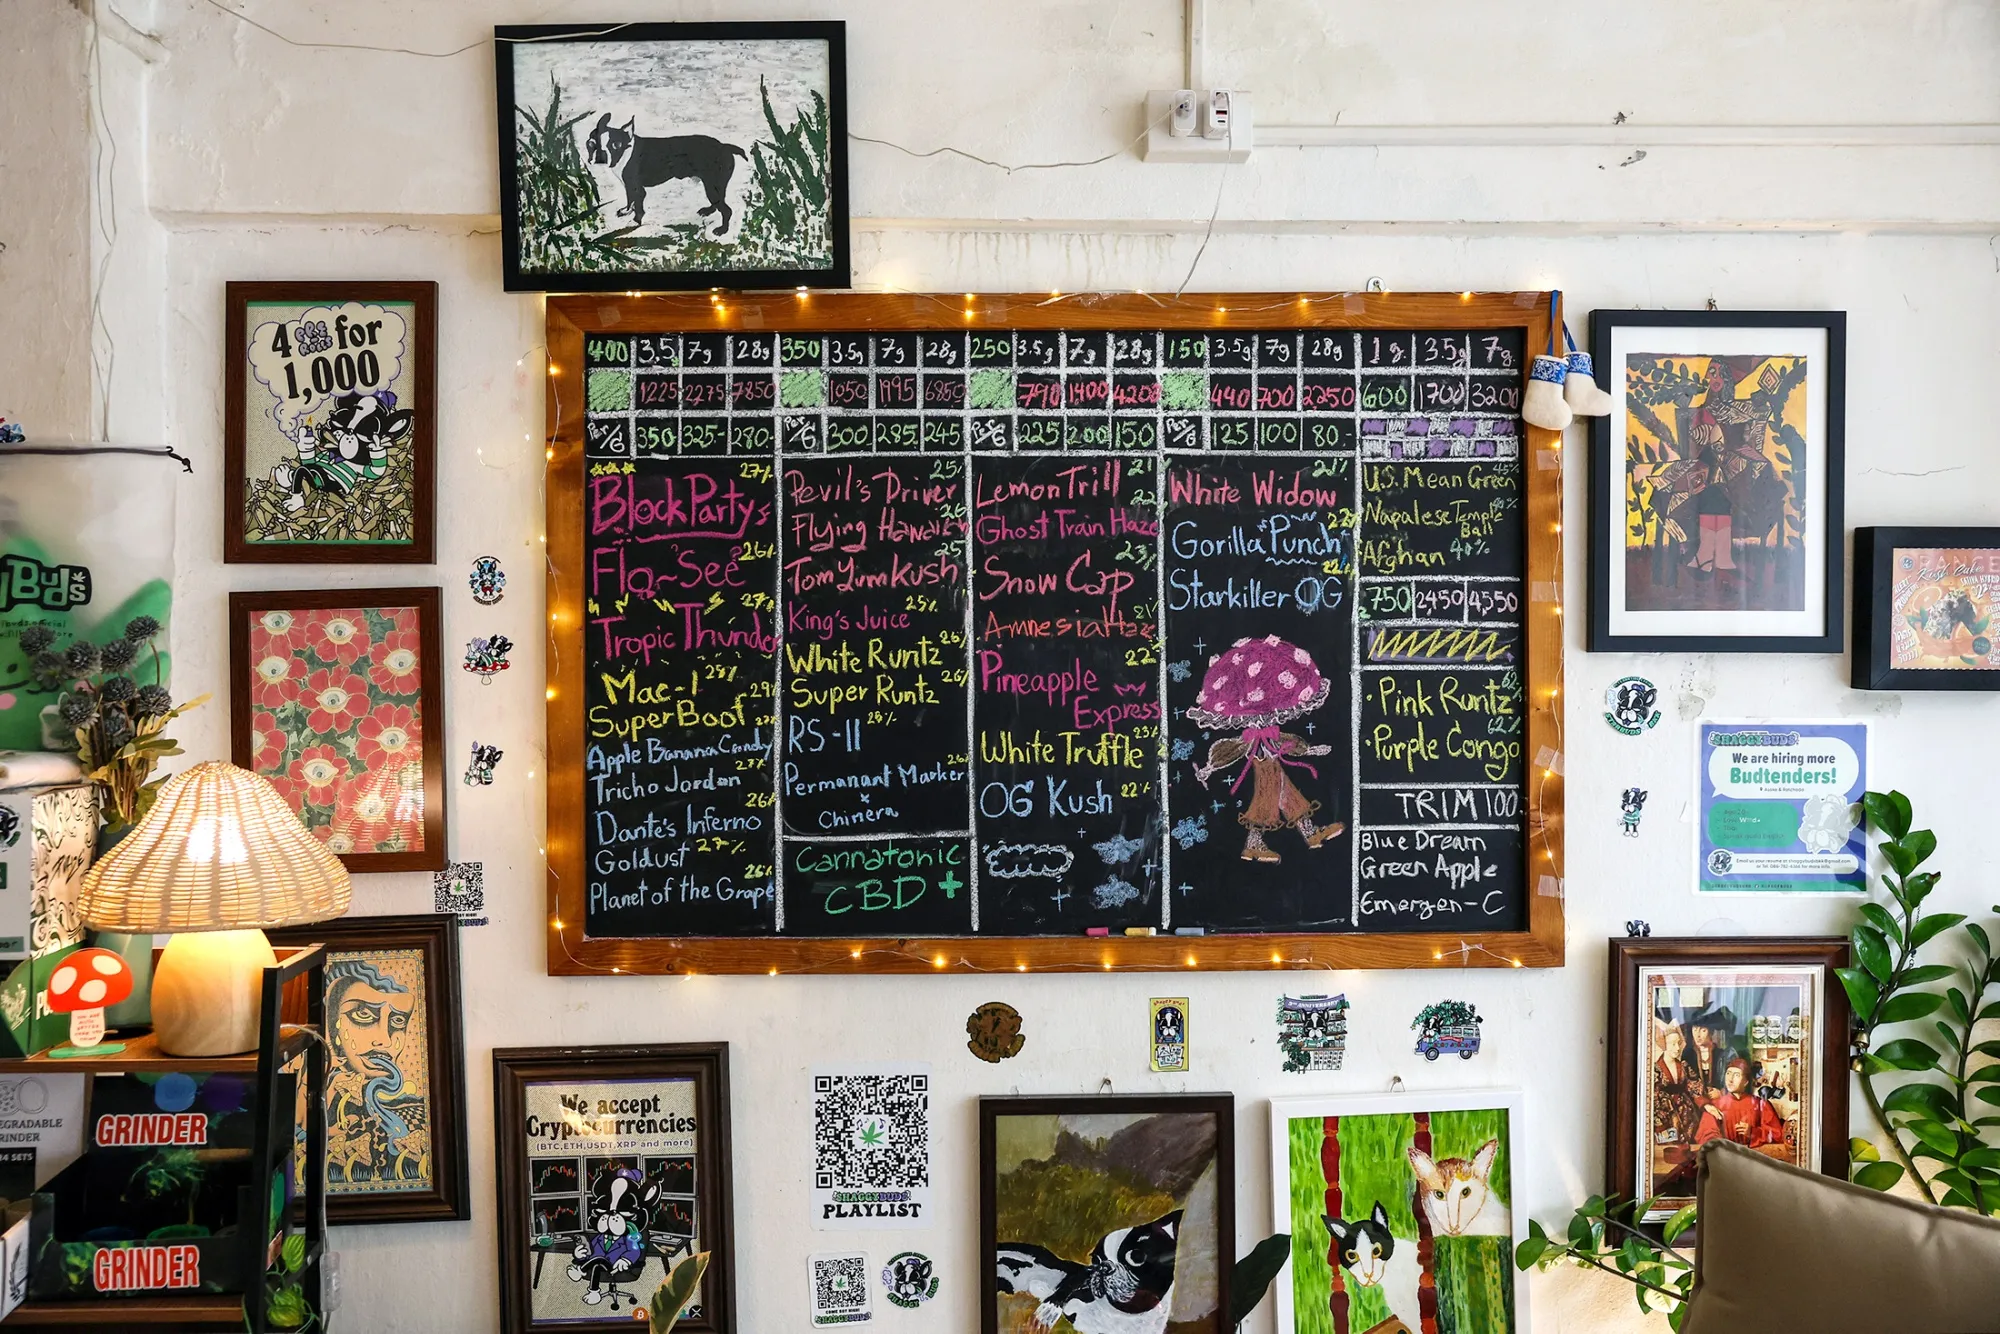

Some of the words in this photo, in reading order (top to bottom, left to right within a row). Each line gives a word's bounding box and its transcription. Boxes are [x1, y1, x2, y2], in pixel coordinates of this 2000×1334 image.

[272, 323, 292, 358] 4
[335, 314, 382, 349] for
[588, 339, 628, 362] 400
[688, 341, 712, 364] 7g
[738, 340, 770, 360] 28g
[781, 338, 820, 362] 350
[832, 340, 864, 364] 3.5g
[881, 338, 905, 363] 7g
[926, 340, 957, 364] 28g
[971, 337, 1010, 359] 250
[1018, 339, 1054, 364] 3.5g
[1069, 338, 1096, 364] 7g
[1115, 338, 1152, 365] 28g
[1169, 338, 1206, 359] 150
[1215, 338, 1250, 361] 3.5g
[1265, 338, 1290, 362] 7g
[1312, 338, 1343, 361] 28g
[1425, 337, 1467, 367] 3.5g
[284, 349, 380, 405] 1,000
[1211, 383, 1251, 408] 440
[1258, 384, 1295, 409] 700
[1362, 383, 1408, 408] 600
[924, 421, 961, 447] 245
[1019, 420, 1061, 446] 225
[1067, 425, 1110, 444] 200
[1115, 420, 1155, 449] 150
[1213, 422, 1249, 447] 125
[1260, 422, 1298, 446] 100
[871, 465, 957, 505] Driver
[976, 473, 1061, 509] Lemon
[1056, 459, 1121, 500] Trill
[1169, 469, 1241, 507] White
[1252, 469, 1337, 507] Widow
[1403, 466, 1463, 489] Mean
[1467, 465, 1516, 490] Green
[791, 512, 868, 553] Flying
[976, 510, 1050, 546] Ghost
[1054, 509, 1105, 539] Train
[1110, 507, 1160, 537] Haze
[1172, 520, 1266, 559] Gorilla
[1460, 522, 1493, 539] Ball
[1363, 539, 1445, 575] Afghan
[979, 555, 1057, 600] Snow
[1065, 548, 1135, 622] Cap
[1169, 568, 1292, 611] Starkiller
[1295, 576, 1342, 609] OG
[1366, 586, 1412, 613] 750
[590, 615, 676, 666] Tropic
[673, 602, 779, 652] Thunder
[788, 601, 850, 640] King's
[856, 604, 911, 631] Juice
[786, 639, 863, 675] White
[868, 635, 944, 669] Runtz
[601, 669, 698, 705] Mac-1
[791, 678, 869, 715] Super
[876, 673, 940, 706] Runtz
[980, 650, 1099, 707] Pineapple
[1379, 676, 1434, 718] Pink
[1439, 676, 1514, 716] Runtz
[1074, 695, 1161, 737] Express
[586, 742, 641, 774] Apple
[646, 738, 719, 764] Banana
[717, 727, 773, 761] Candy
[980, 729, 1055, 765] White
[1057, 732, 1144, 769] Truffle
[1374, 721, 1440, 772] Purple
[1446, 720, 1520, 781] Congo
[1732, 753, 1748, 764] We
[1751, 755, 1769, 764] are
[1771, 752, 1804, 766] hiring
[1807, 755, 1836, 764] more
[589, 771, 659, 805] Tricho
[664, 765, 742, 793] Jordan
[897, 762, 965, 788] Marker
[1730, 767, 1837, 784] Budtenders!
[980, 779, 1034, 818] OG
[1046, 774, 1112, 817] Kush
[1395, 790, 1478, 821] TRIM
[592, 810, 677, 845] Dante's
[686, 803, 762, 836] Inferno
[818, 806, 900, 829] Chimera
[595, 841, 691, 875] Goldust
[796, 840, 961, 873] Cannatonic
[1361, 831, 1409, 850] Blue
[1415, 830, 1487, 851] Dream
[1360, 856, 1429, 879] Green
[1435, 853, 1498, 890] Apple
[590, 878, 649, 915] Planet
[651, 877, 674, 905] of
[680, 874, 712, 902] the
[824, 876, 927, 914] CBD
[1360, 890, 1506, 920] Emergen-C
[560, 1094, 588, 1115] We
[597, 1094, 661, 1117] accept
[96, 1113, 208, 1147] GRINDER
[640, 1140, 659, 1148] and
[663, 1138, 693, 1148] more)
[823, 1203, 922, 1219] PLAYLIST
[93, 1245, 200, 1292] GRINDER
